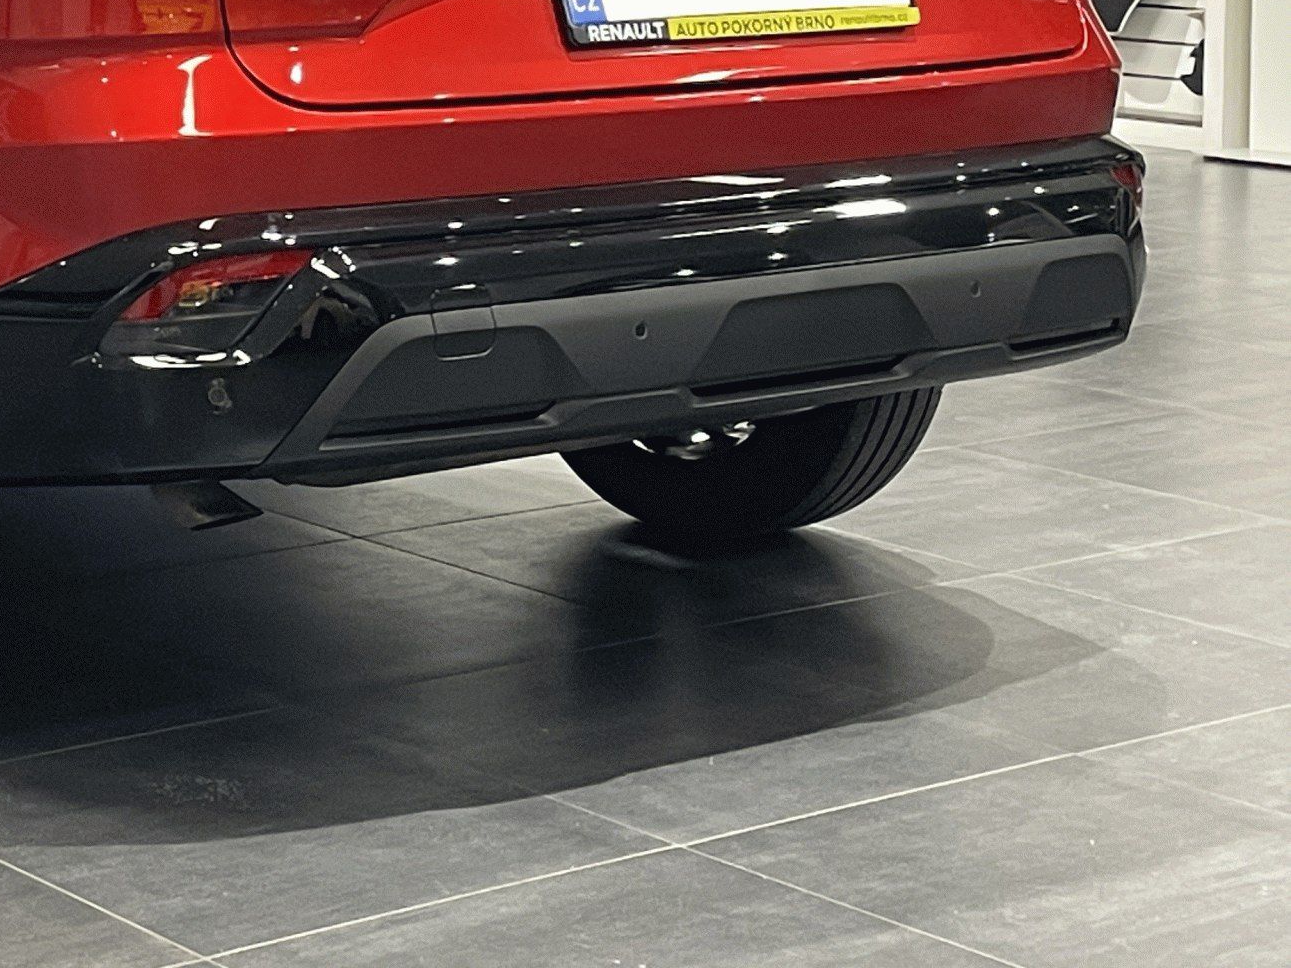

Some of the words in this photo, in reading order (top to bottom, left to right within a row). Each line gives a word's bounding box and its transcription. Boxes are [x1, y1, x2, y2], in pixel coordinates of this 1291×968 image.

[587, 21, 666, 43] RENAULT
[675, 20, 718, 37] AUTO
[722, 15, 793, 35] POKORNÝ
[796, 14, 836, 32] BRNO
